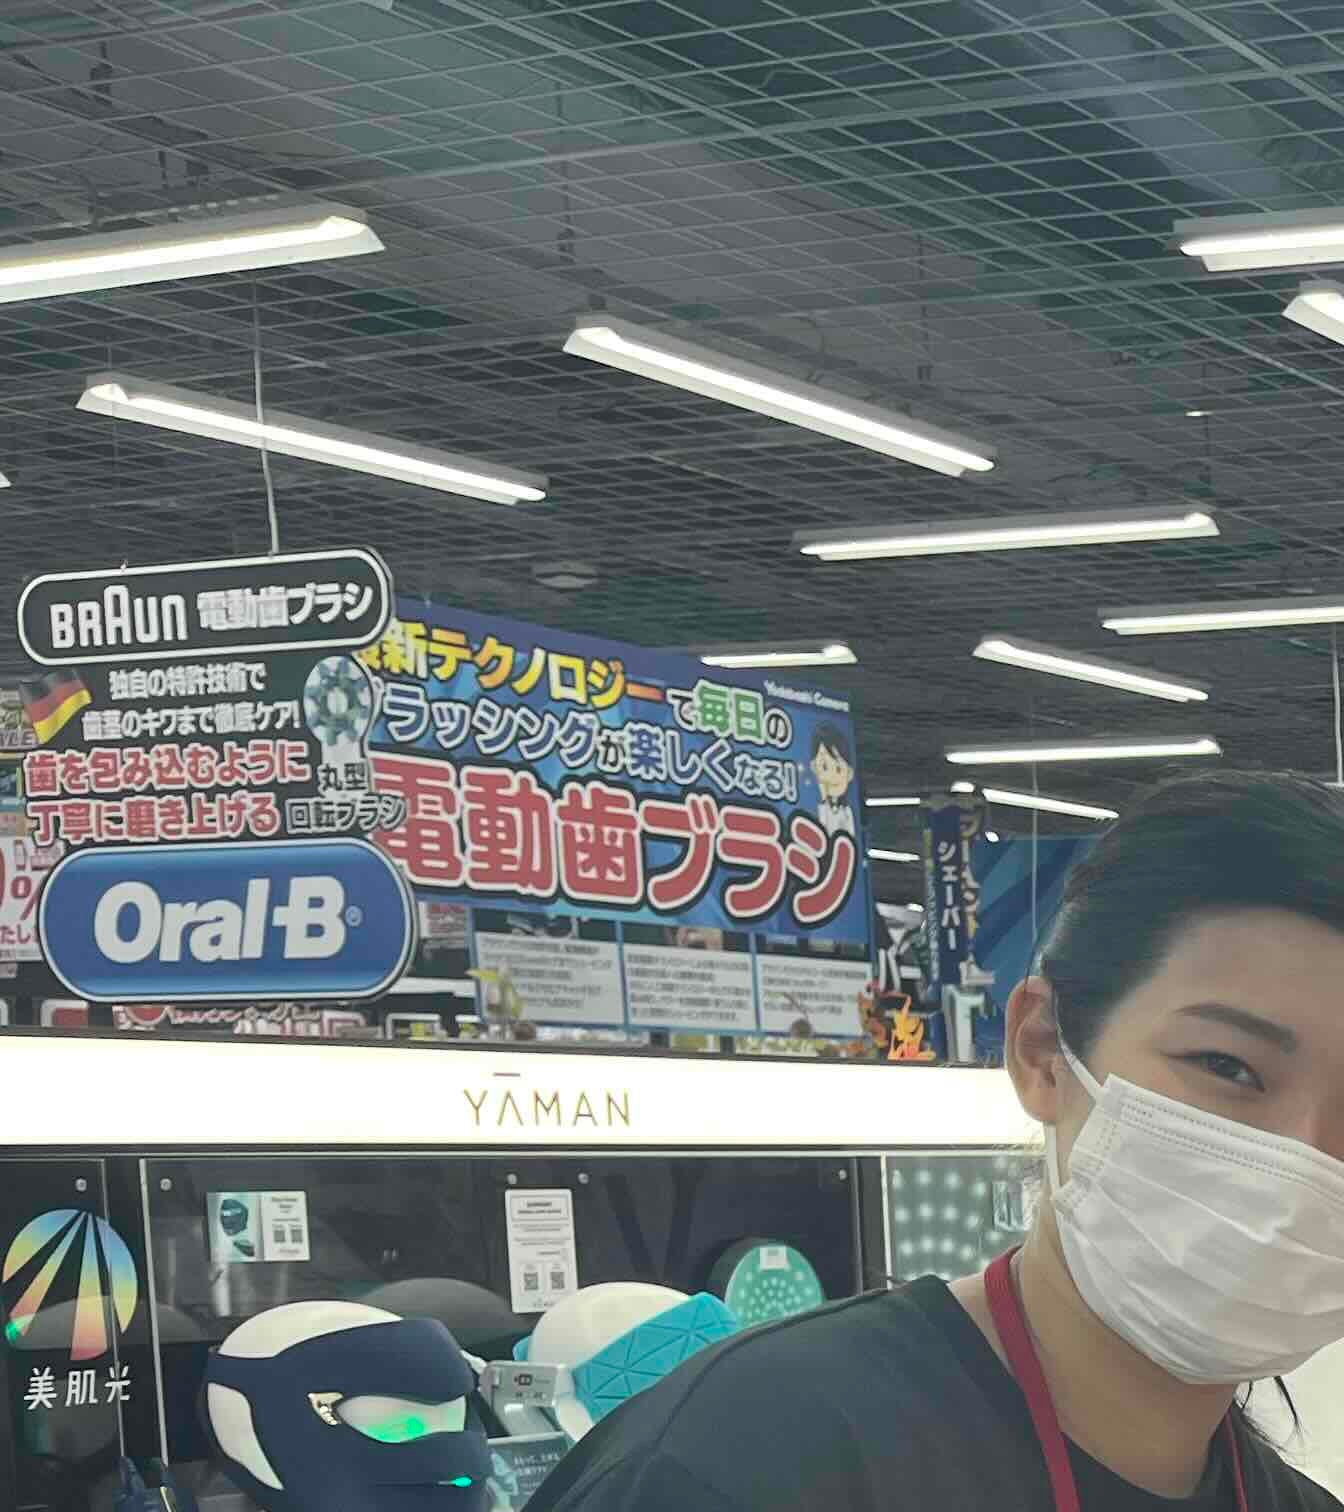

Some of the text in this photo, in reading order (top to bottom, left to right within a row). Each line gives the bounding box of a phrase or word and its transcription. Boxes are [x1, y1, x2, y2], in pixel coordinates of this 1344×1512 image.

[50, 582, 374, 650] BRAUN 電動歯ブラシ
[109, 662, 266, 701] 独自の特許技術で
[81, 700, 300, 742] 歯茎のキワまで徹底ケア!
[366, 678, 798, 801] ラッシングが楽しくなる!
[24, 738, 312, 797] 歯を包み込むように
[27, 790, 281, 846] 丁寧に磨き上げる
[368, 750, 856, 922] 電動歯ブラシ
[93, 875, 348, 964] Oral-B
[23, 1364, 133, 1411] 美肌光
